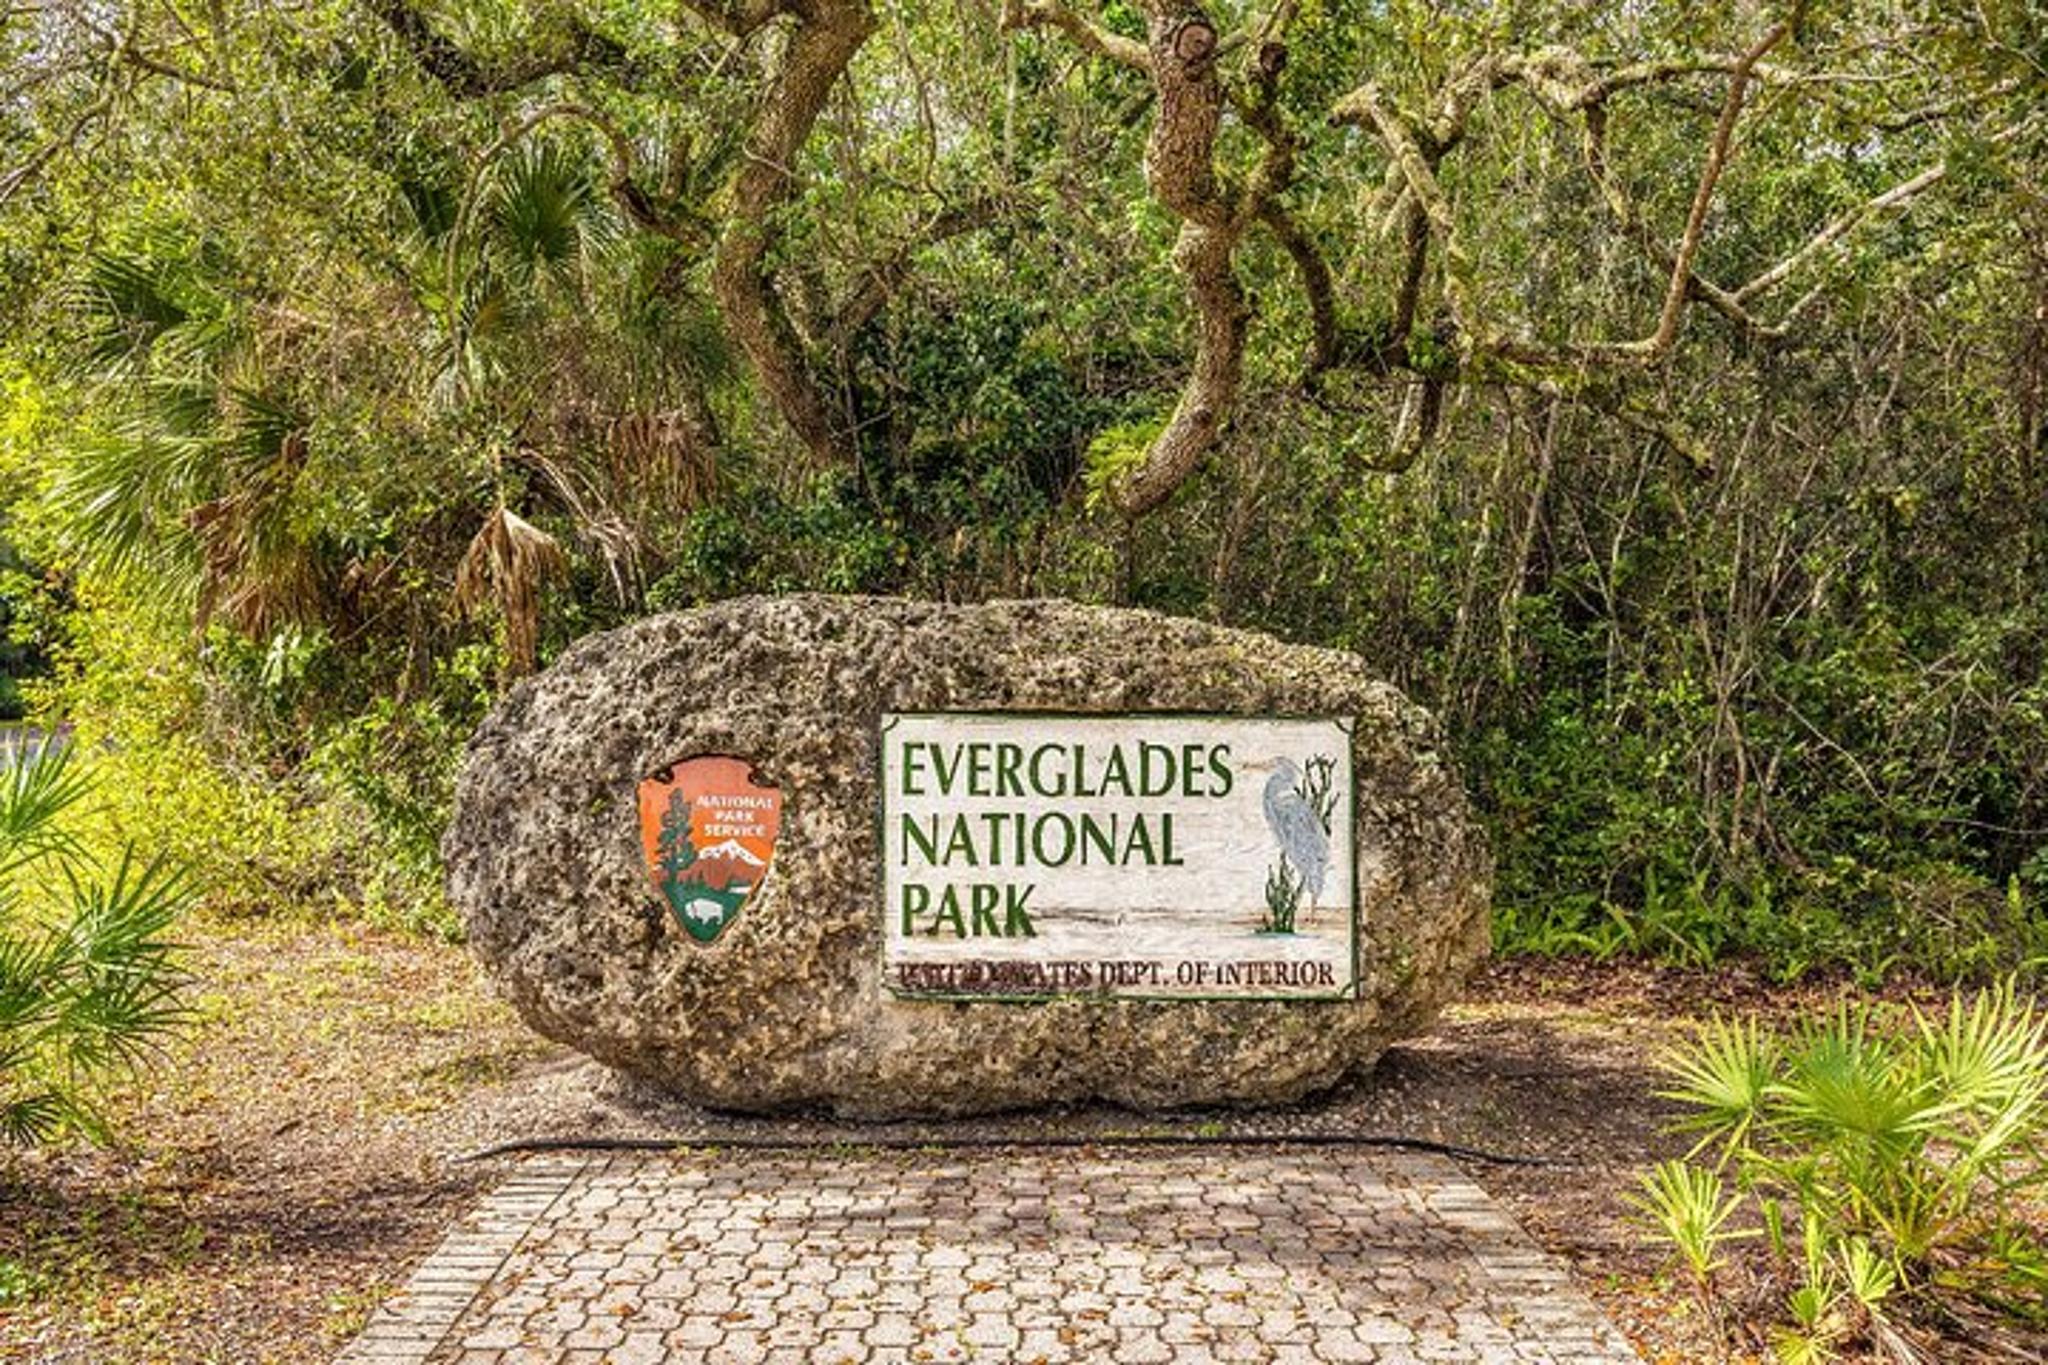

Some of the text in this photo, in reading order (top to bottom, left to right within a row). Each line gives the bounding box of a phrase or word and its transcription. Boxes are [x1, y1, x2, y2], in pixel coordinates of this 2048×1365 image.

[901, 740, 1233, 797] EVERGLADES
[696, 795, 773, 808] NATIONAL
[715, 810, 755, 822] PARK
[704, 824, 767, 837] SERVICE
[901, 812, 1184, 867] NATIONAL
[901, 883, 1037, 938] PARK
[1098, 961, 1171, 987] DEPT.
[1177, 961, 1210, 986] OF
[1215, 961, 1336, 987] INTERIOR
